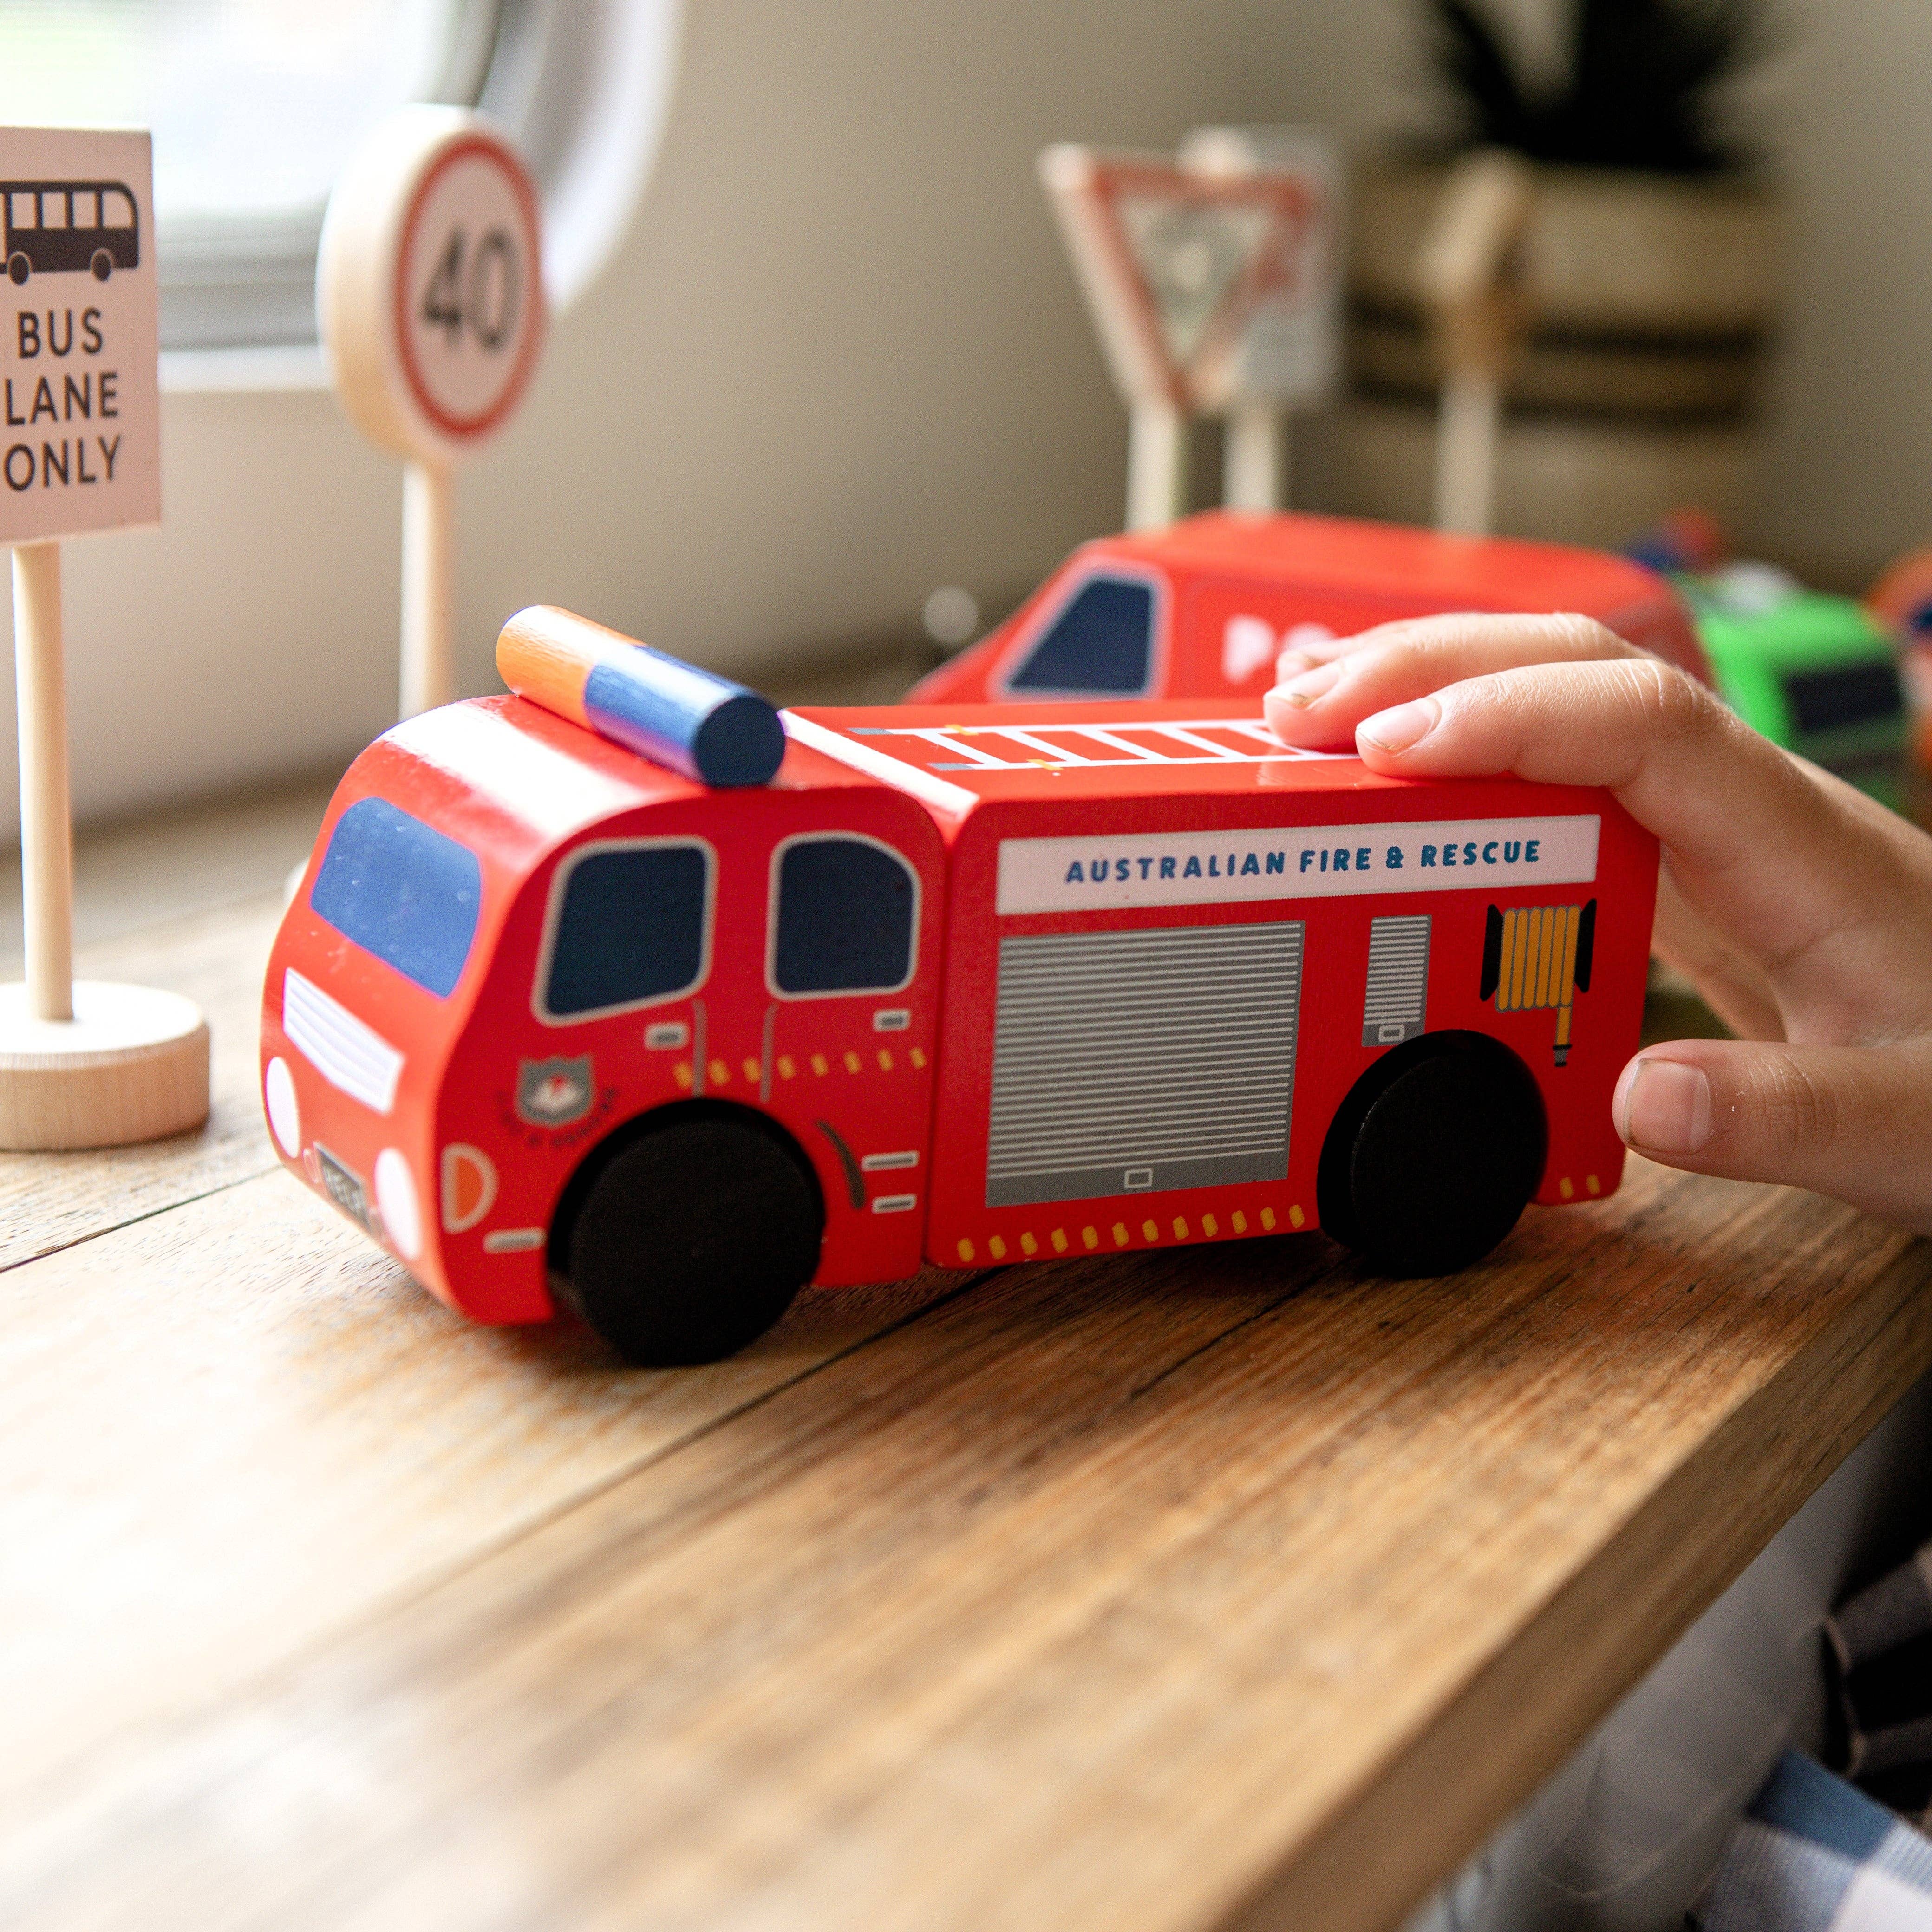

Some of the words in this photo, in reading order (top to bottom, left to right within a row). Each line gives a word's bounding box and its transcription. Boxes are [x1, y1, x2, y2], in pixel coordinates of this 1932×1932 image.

[422, 224, 522, 355] 40
[17, 307, 103, 359] BUS
[5, 371, 118, 426] LANE
[4, 435, 121, 491] ONLY
[1065, 851, 1286, 883] AUSTRALIAN
[1299, 847, 1372, 873] FIRE
[1385, 845, 1405, 870] &
[1420, 839, 1541, 868] RESCUE
